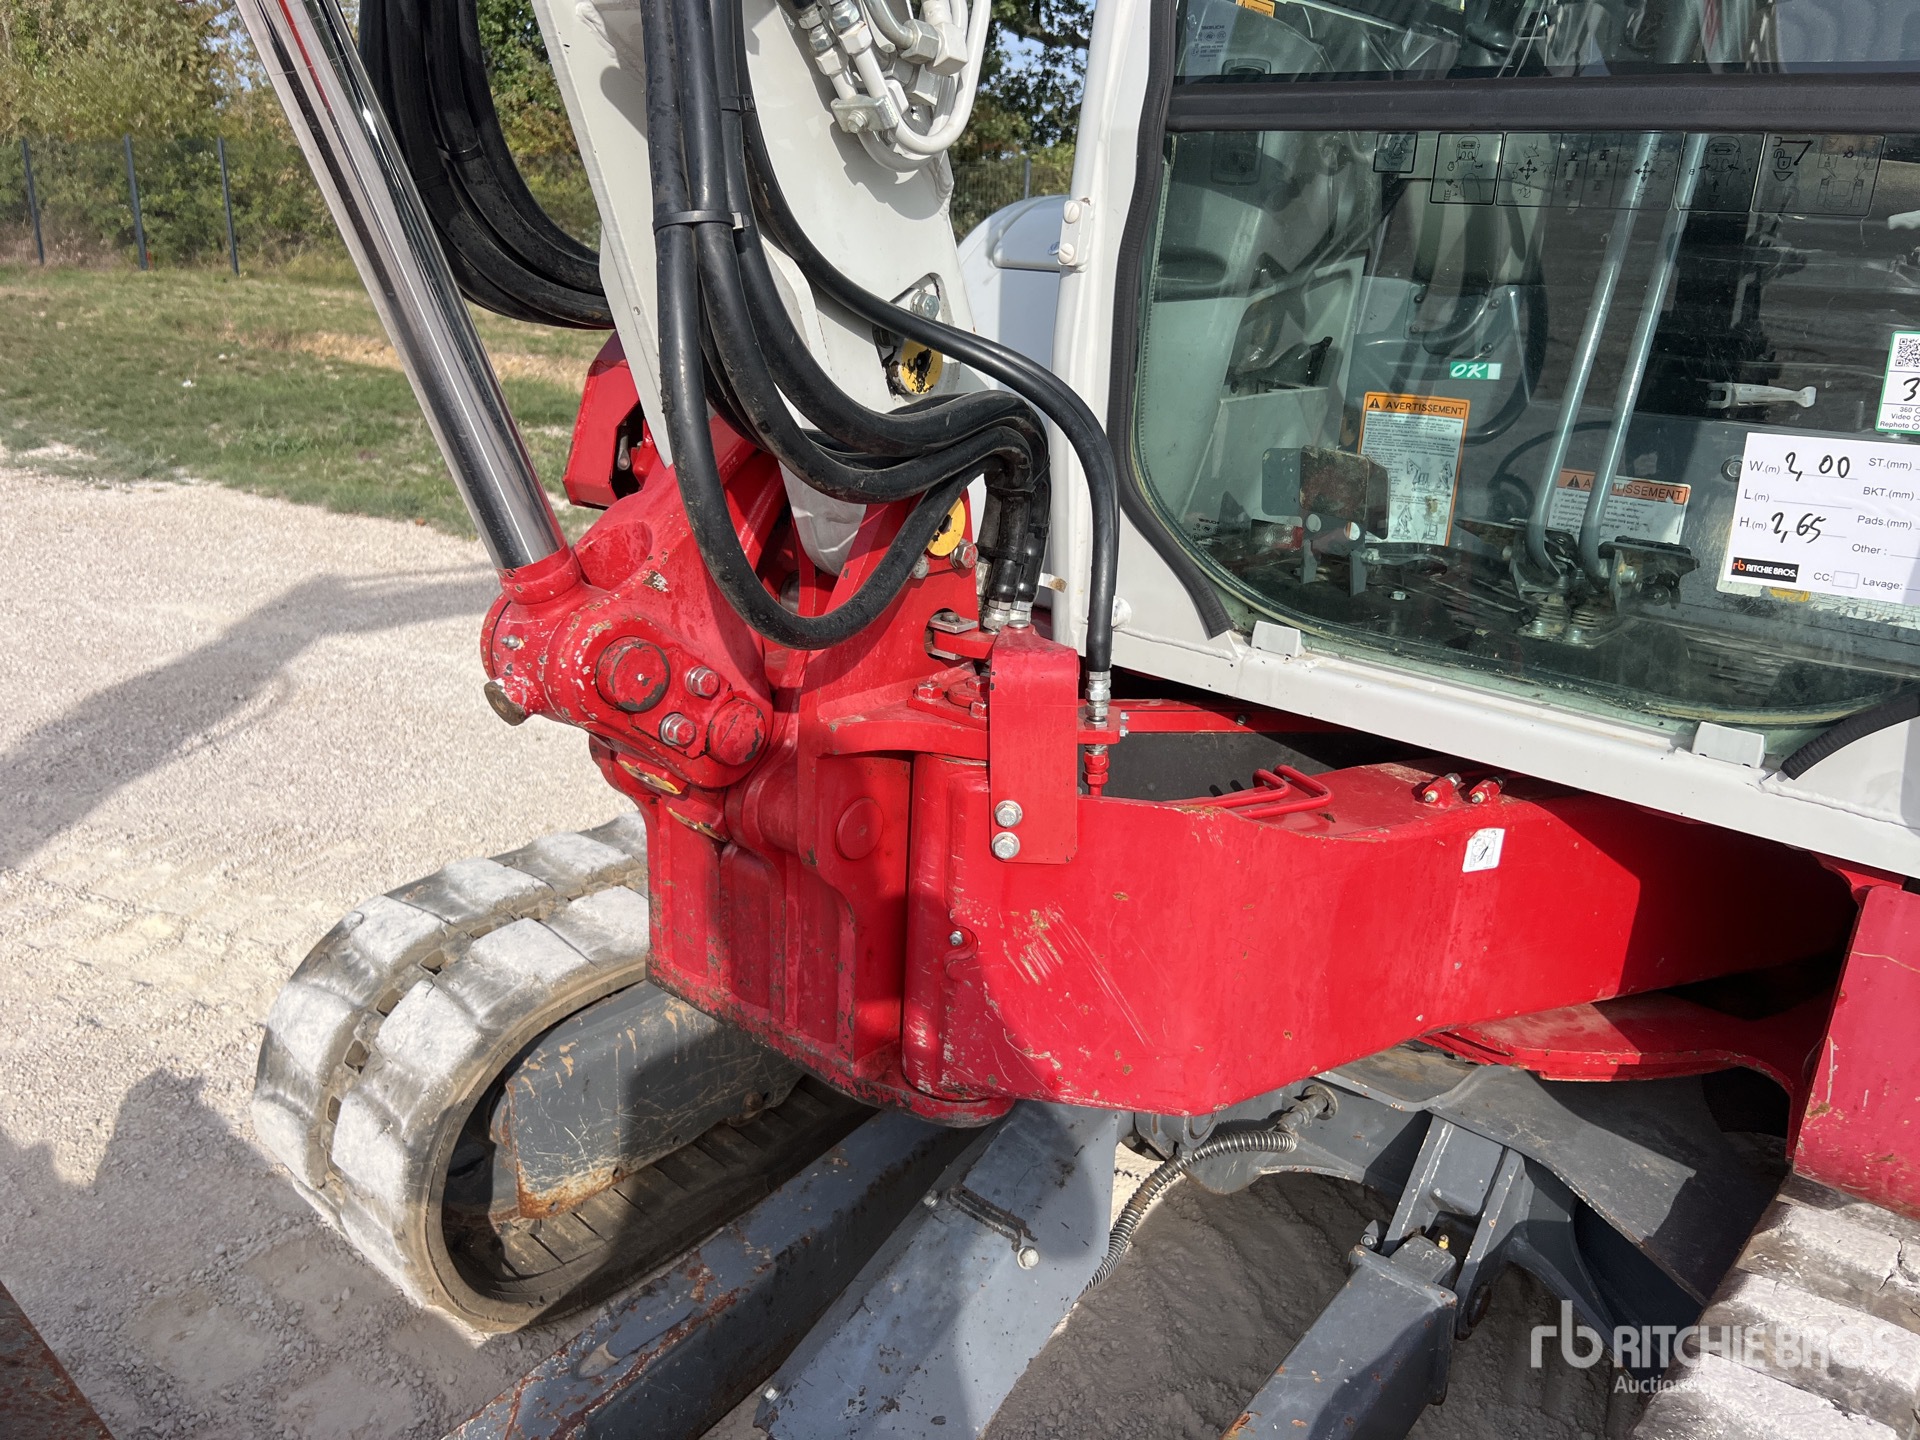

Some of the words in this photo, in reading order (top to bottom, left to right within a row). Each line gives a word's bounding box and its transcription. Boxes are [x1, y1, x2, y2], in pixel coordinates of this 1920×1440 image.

[1451, 363, 1486, 378] OK
[1903, 377, 1920, 401] 3
[1385, 401, 1464, 416] AVERTISSEMENT
[1880, 420, 1909, 428] Rephoto
[1749, 460, 1781, 475] W.(m)
[1868, 457, 1912, 471] ST.(mm)
[1744, 489, 1770, 502] L.(m)
[1863, 486, 1914, 501] BKT.(mm)
[1739, 516, 1767, 531] H.(m)
[1857, 514, 1912, 530] Pads.(mm)
[1746, 563, 1772, 575] RITCHIE
[1813, 571, 1833, 582] CC:
[1862, 577, 1903, 591] Lavage:
